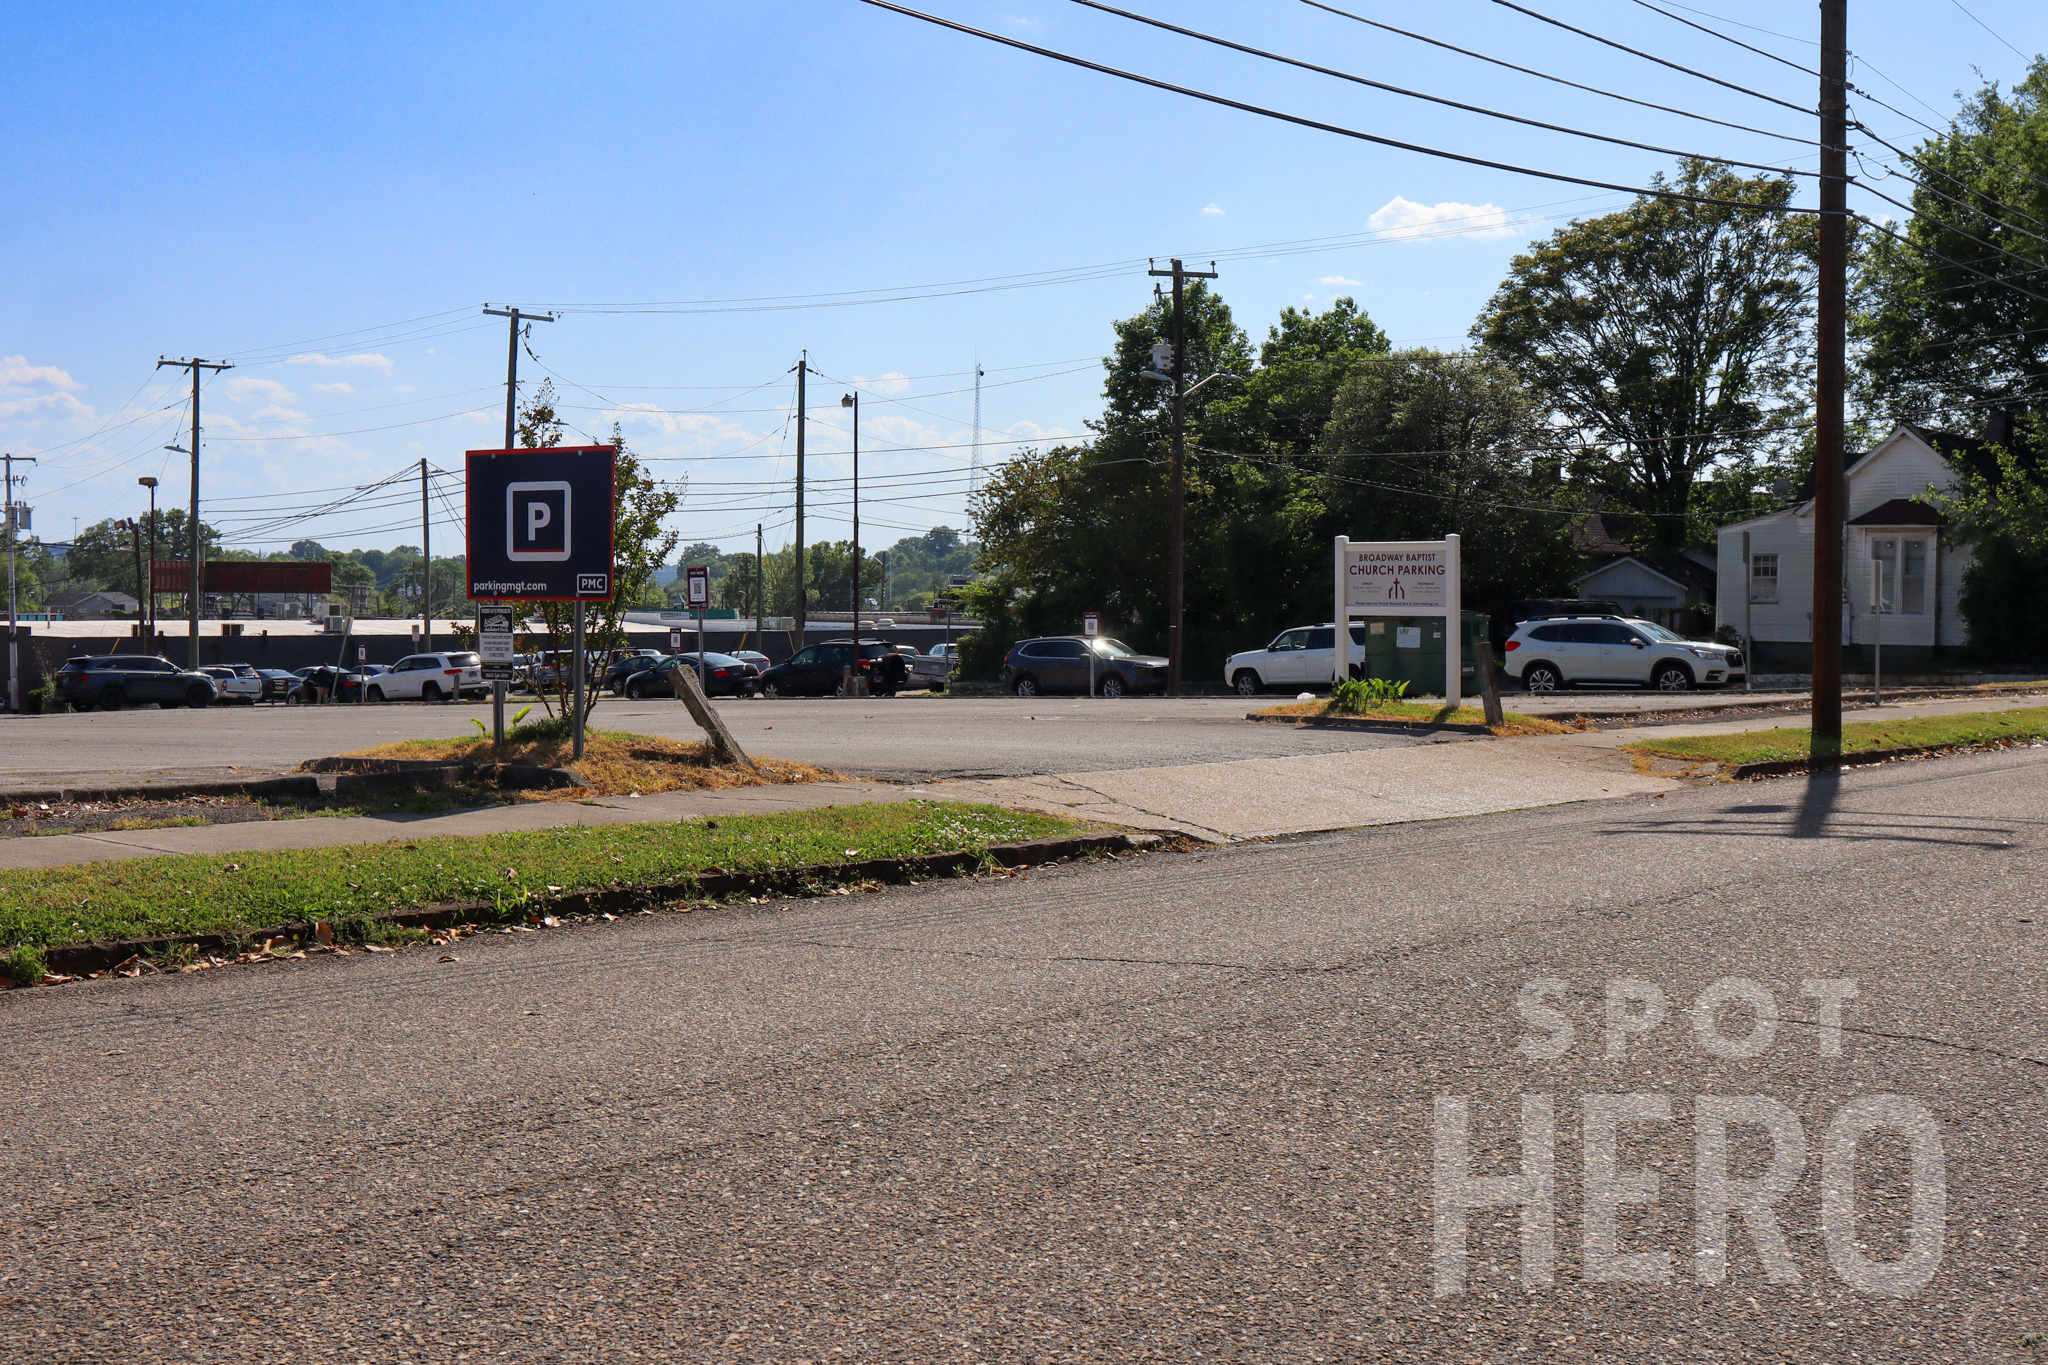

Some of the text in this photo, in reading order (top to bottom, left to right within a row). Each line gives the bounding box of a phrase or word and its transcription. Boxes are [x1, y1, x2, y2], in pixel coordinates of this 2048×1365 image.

[528, 502, 551, 541] P
[1358, 553, 1436, 561] BROADWAY BAPTIST
[1349, 565, 1445, 575] CHURCH PARKING
[473, 578, 603, 594] parkingmgt.com PMC
